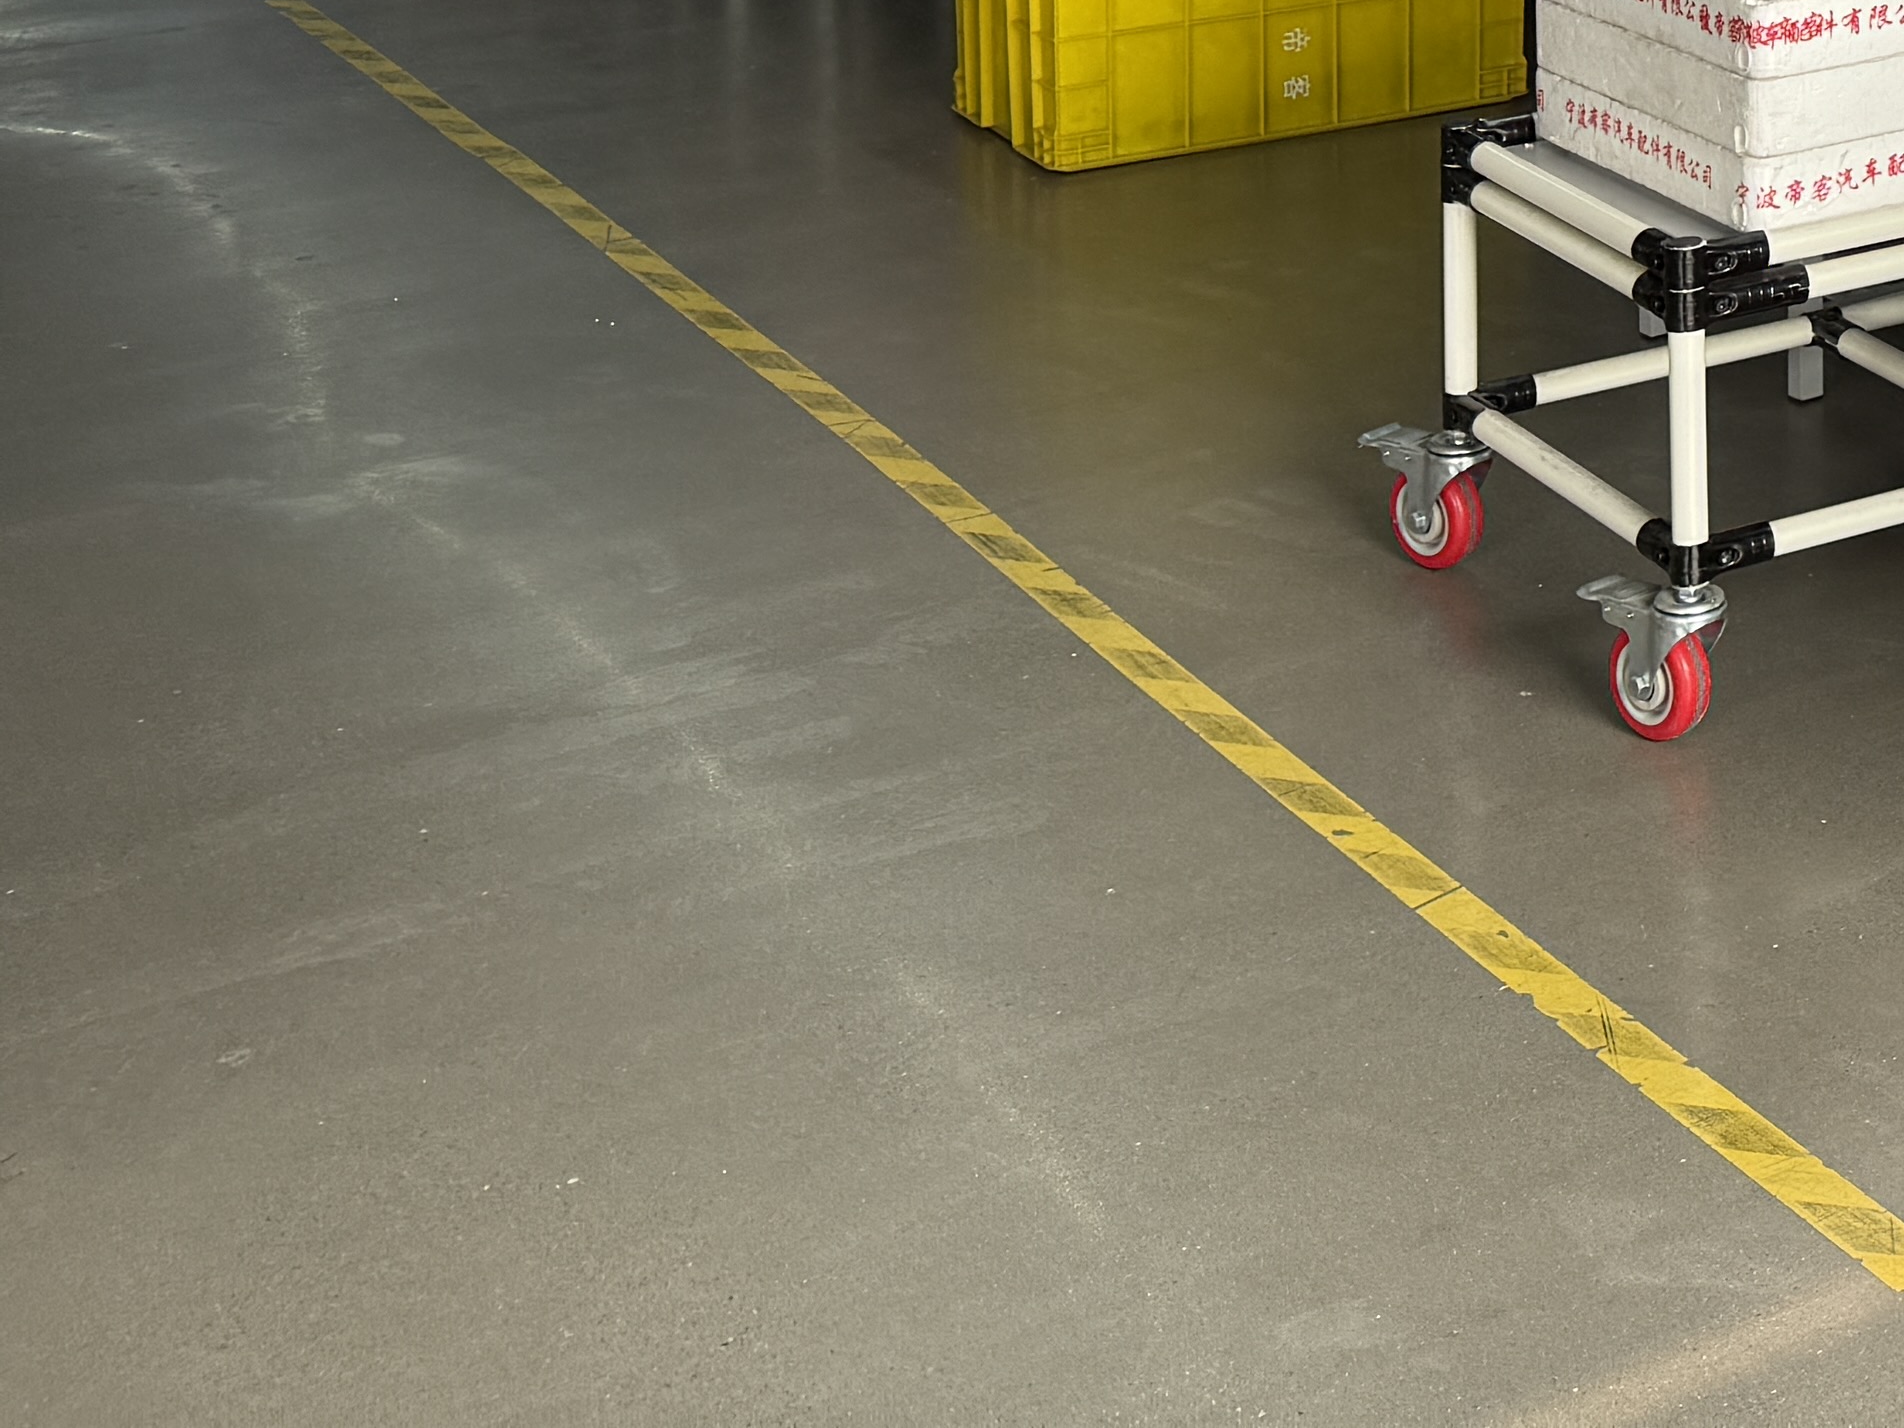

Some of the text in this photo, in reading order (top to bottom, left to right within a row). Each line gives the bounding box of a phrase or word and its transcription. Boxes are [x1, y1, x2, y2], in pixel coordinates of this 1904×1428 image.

[1566, 99, 1713, 189] 宁波帝客汽车配件有限公司
